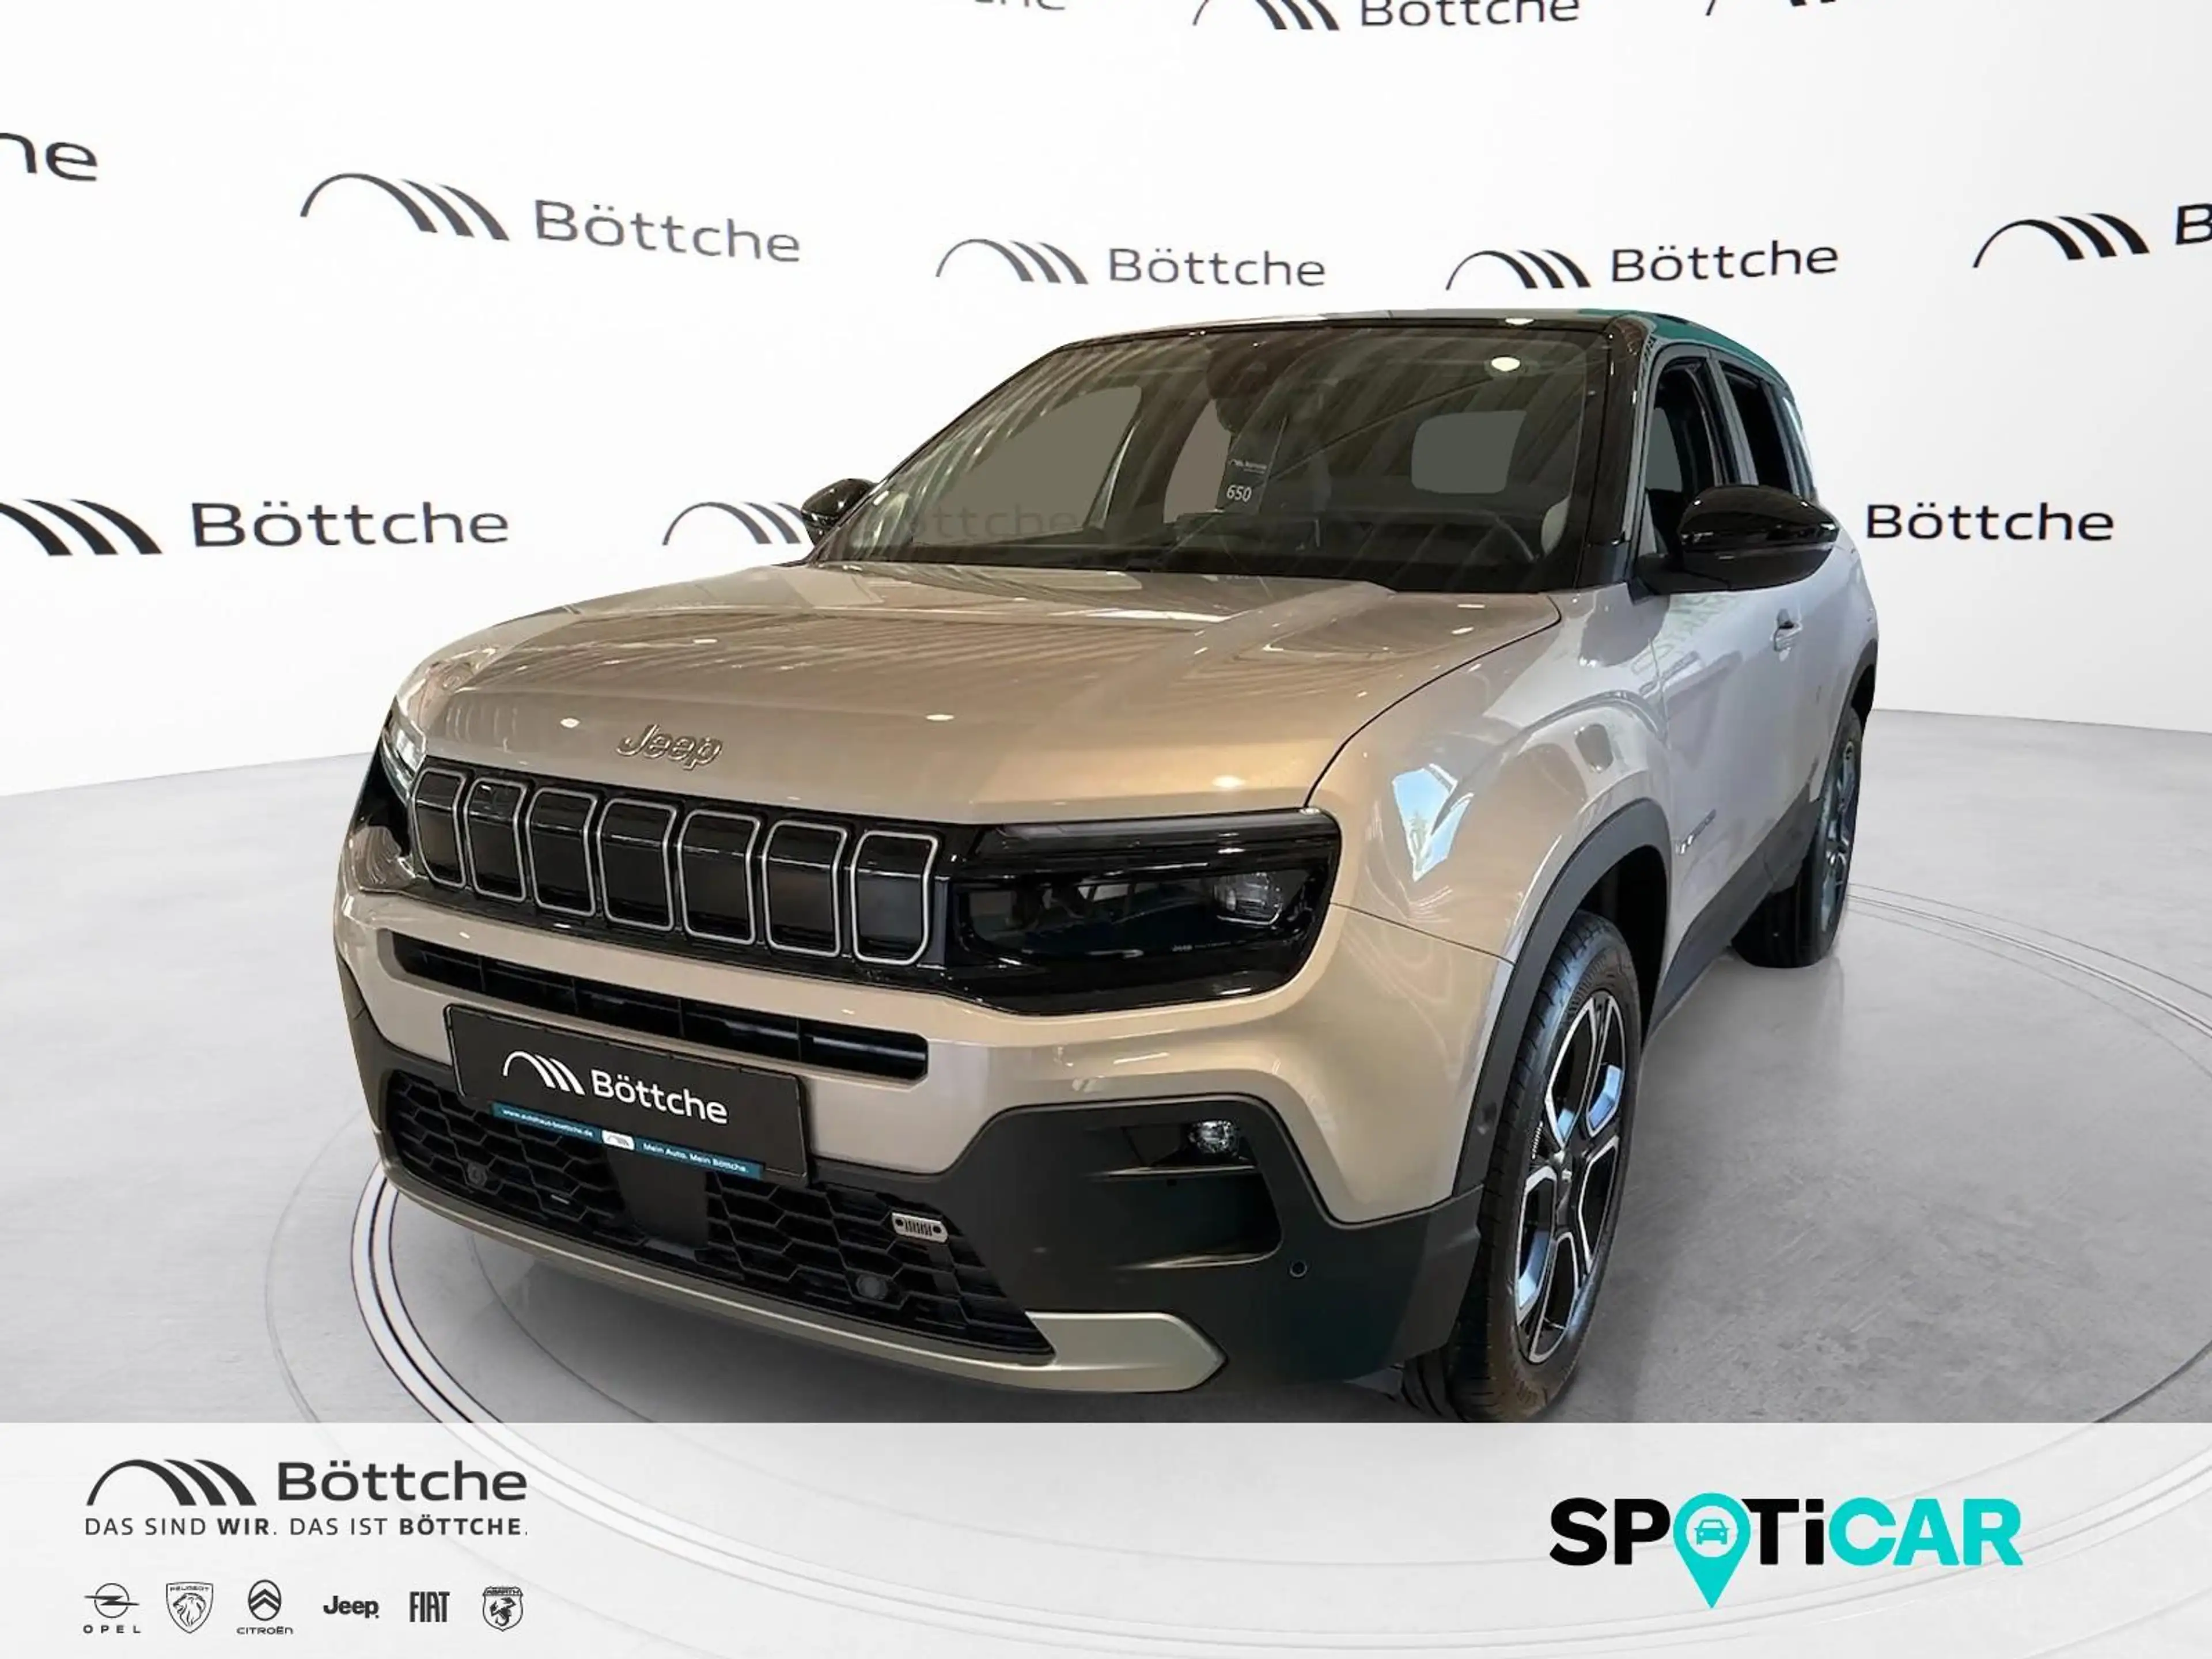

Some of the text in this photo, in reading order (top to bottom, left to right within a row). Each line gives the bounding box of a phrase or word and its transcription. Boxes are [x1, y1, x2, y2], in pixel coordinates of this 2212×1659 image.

[535, 200, 799, 262] Böttche
[1109, 248, 1325, 287] Böttche
[1612, 240, 1838, 282] Böttche
[1226, 484, 1252, 502] 650
[191, 501, 508, 547] Böttche
[1867, 502, 2114, 541] Böttche
[616, 724, 723, 771] Jeep
[590, 1069, 728, 1124] Böttche
